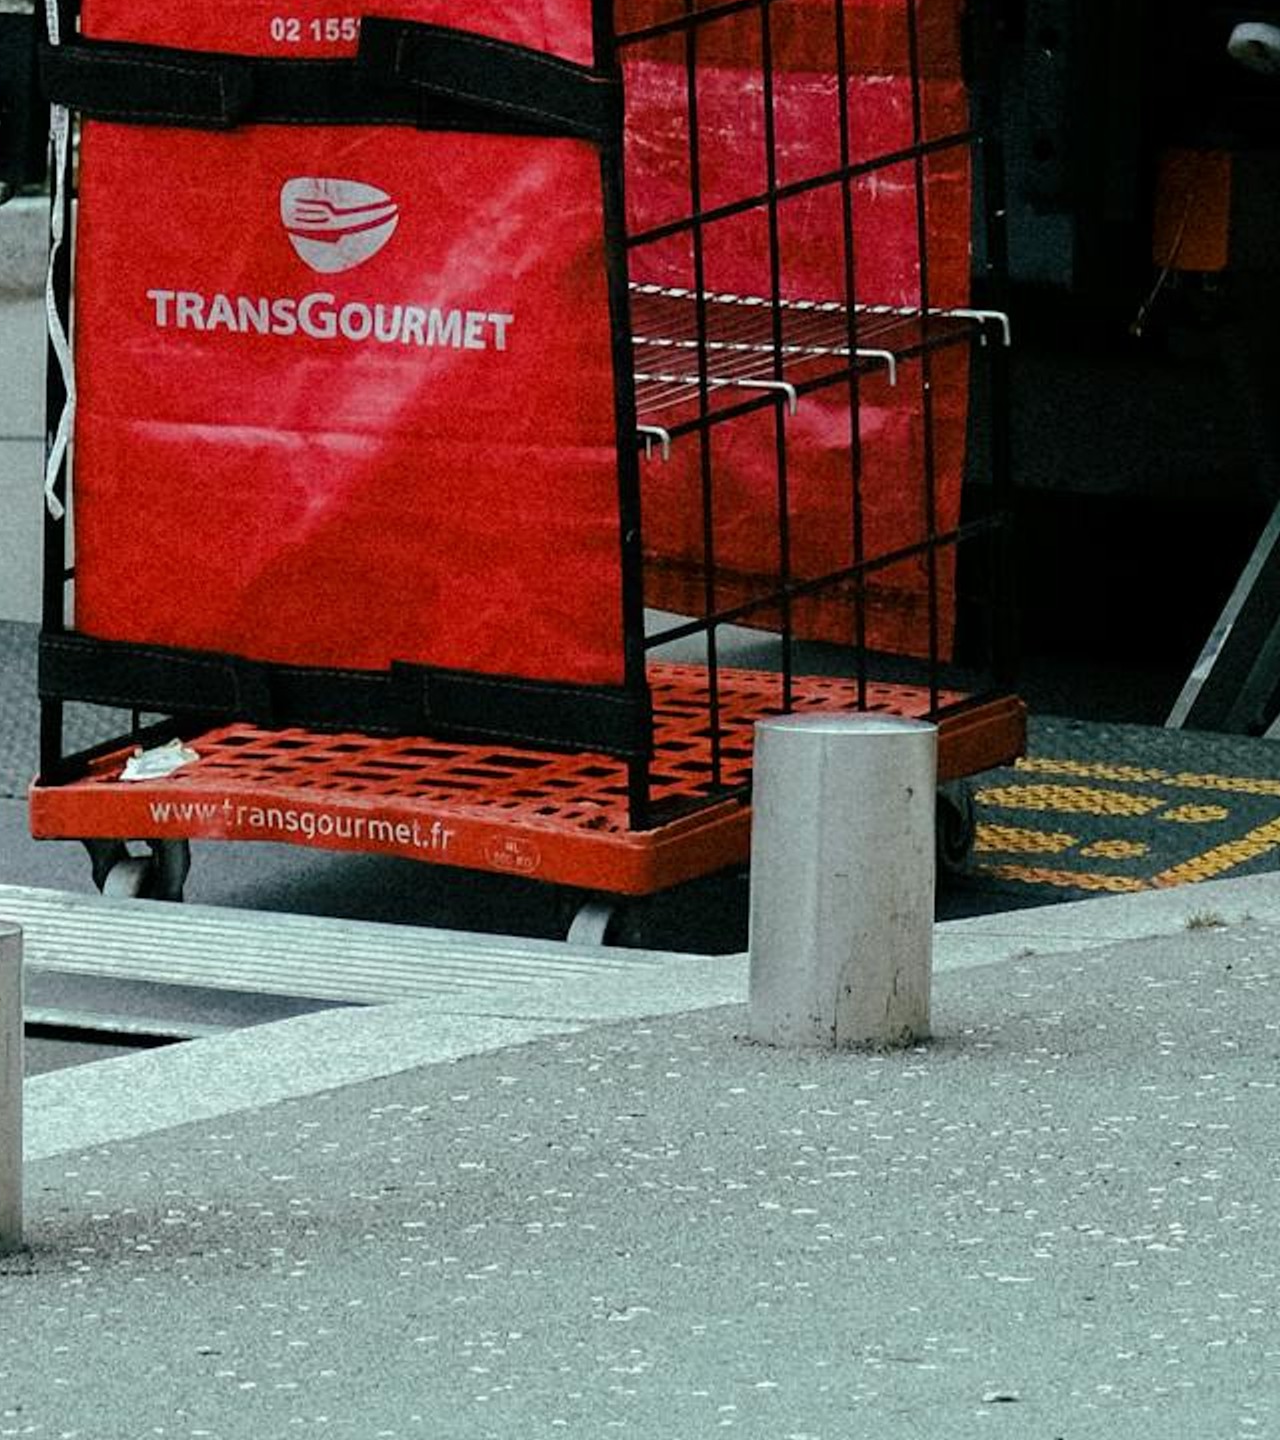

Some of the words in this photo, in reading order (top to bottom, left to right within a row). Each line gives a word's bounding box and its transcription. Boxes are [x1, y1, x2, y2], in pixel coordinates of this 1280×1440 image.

[270, 17, 301, 41] 02
[309, 18, 362, 41] 155
[146, 288, 514, 351] TRANSGOURMET
[150, 798, 454, 850] wwwtransgourmet.fr
